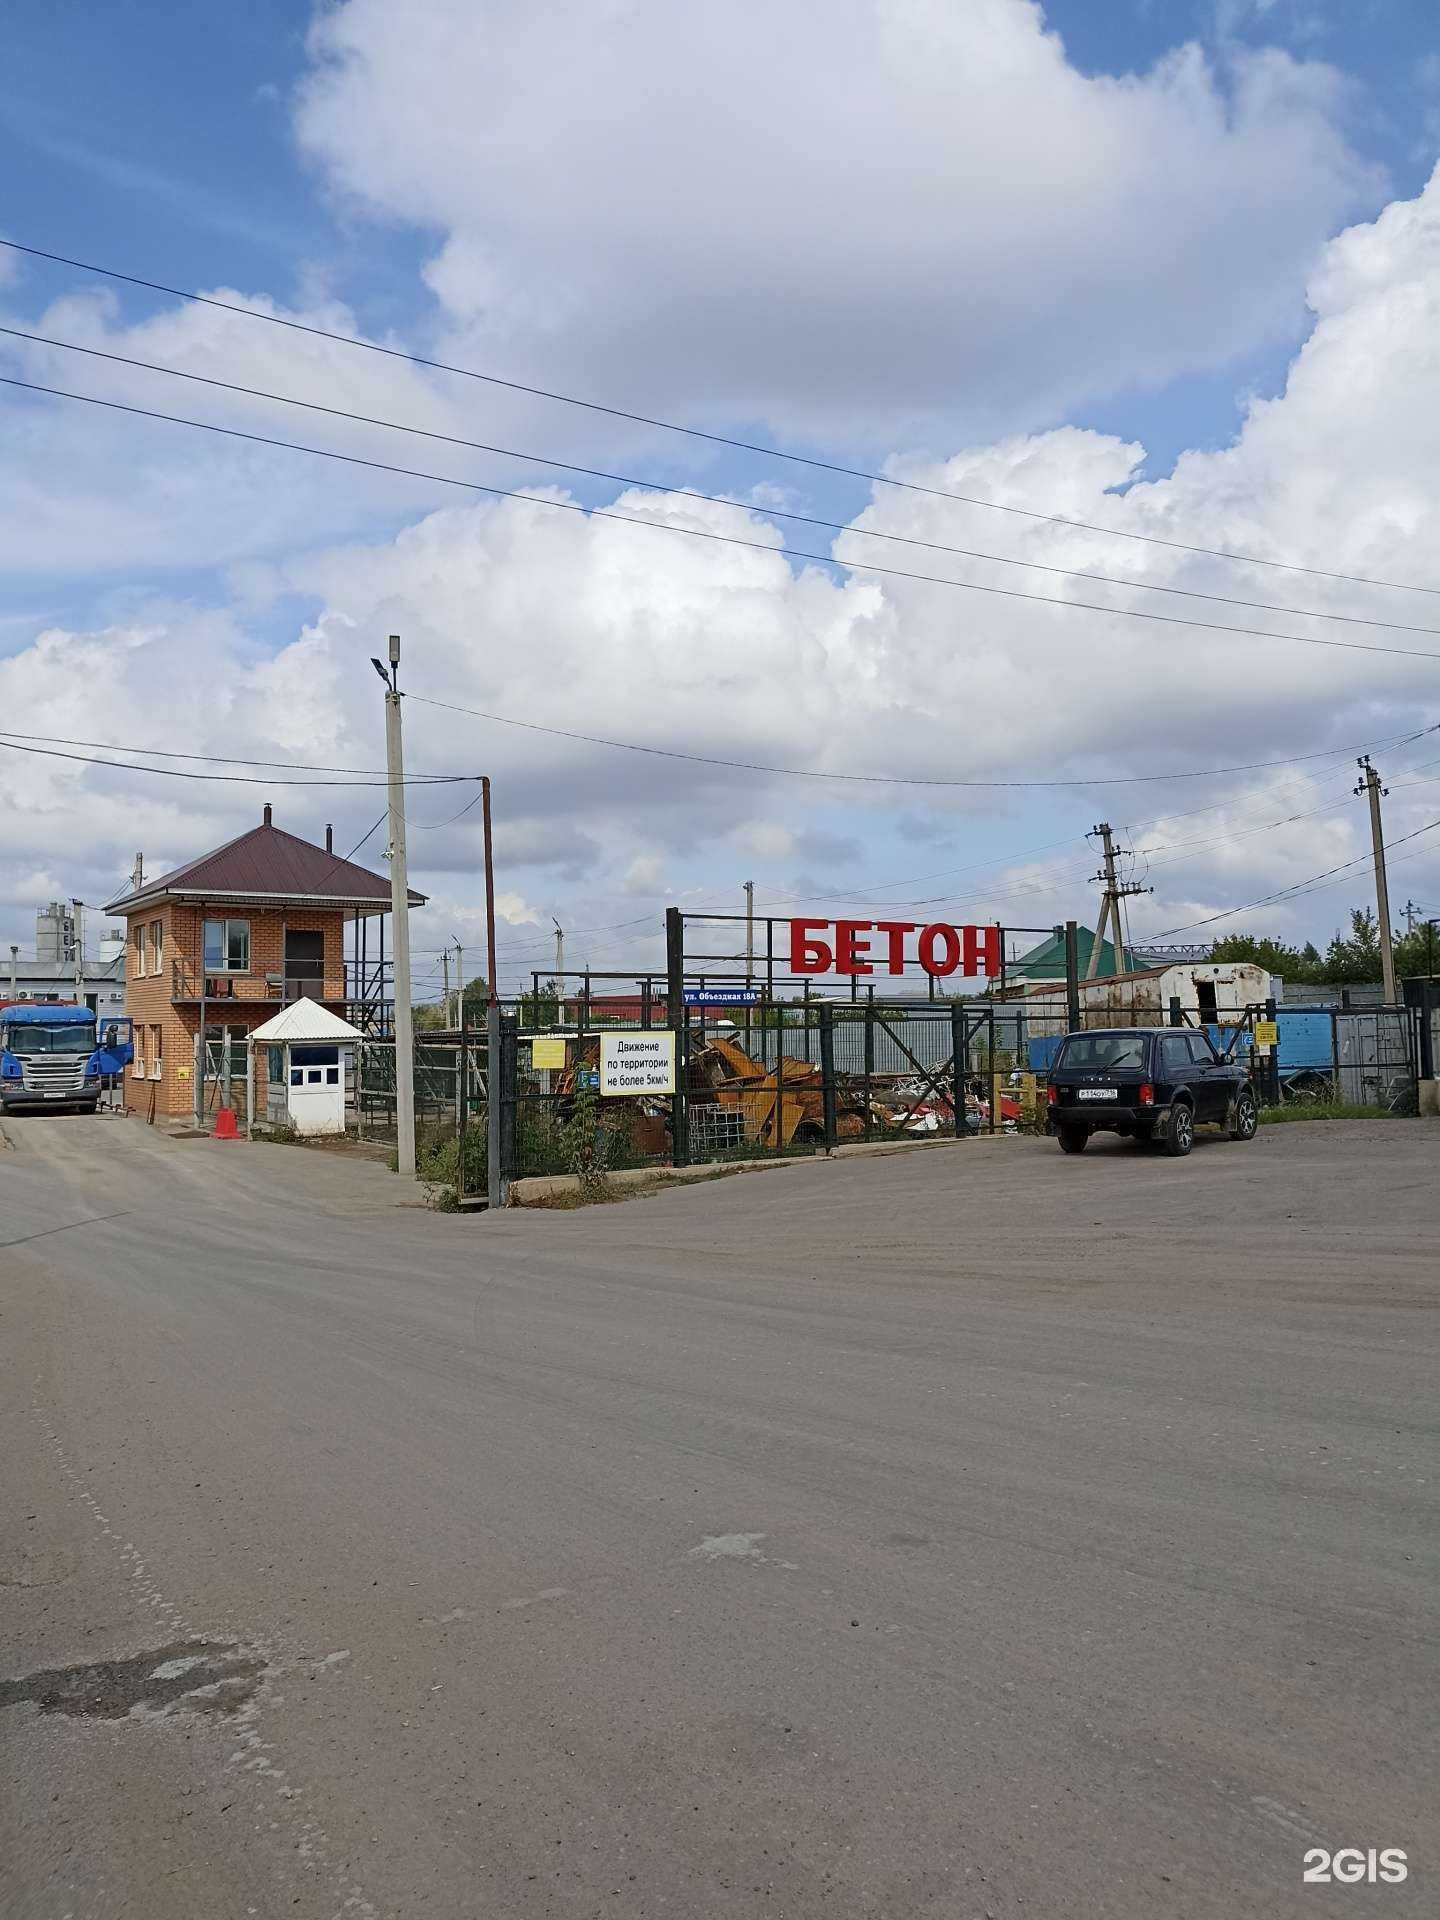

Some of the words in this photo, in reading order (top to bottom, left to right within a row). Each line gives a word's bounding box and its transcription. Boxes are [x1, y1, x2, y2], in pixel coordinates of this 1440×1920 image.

[791, 918, 999, 976] БЕТОН
[684, 994, 697, 1002] ул.
[699, 992, 741, 1000] Объездная
[617, 1041, 660, 1053] Движение
[607, 1060, 618, 1069] по
[620, 1059, 669, 1070] территории
[607, 1078, 618, 1086] не
[620, 1075, 645, 1086] более
[646, 1074, 669, 1085] 5км/ч
